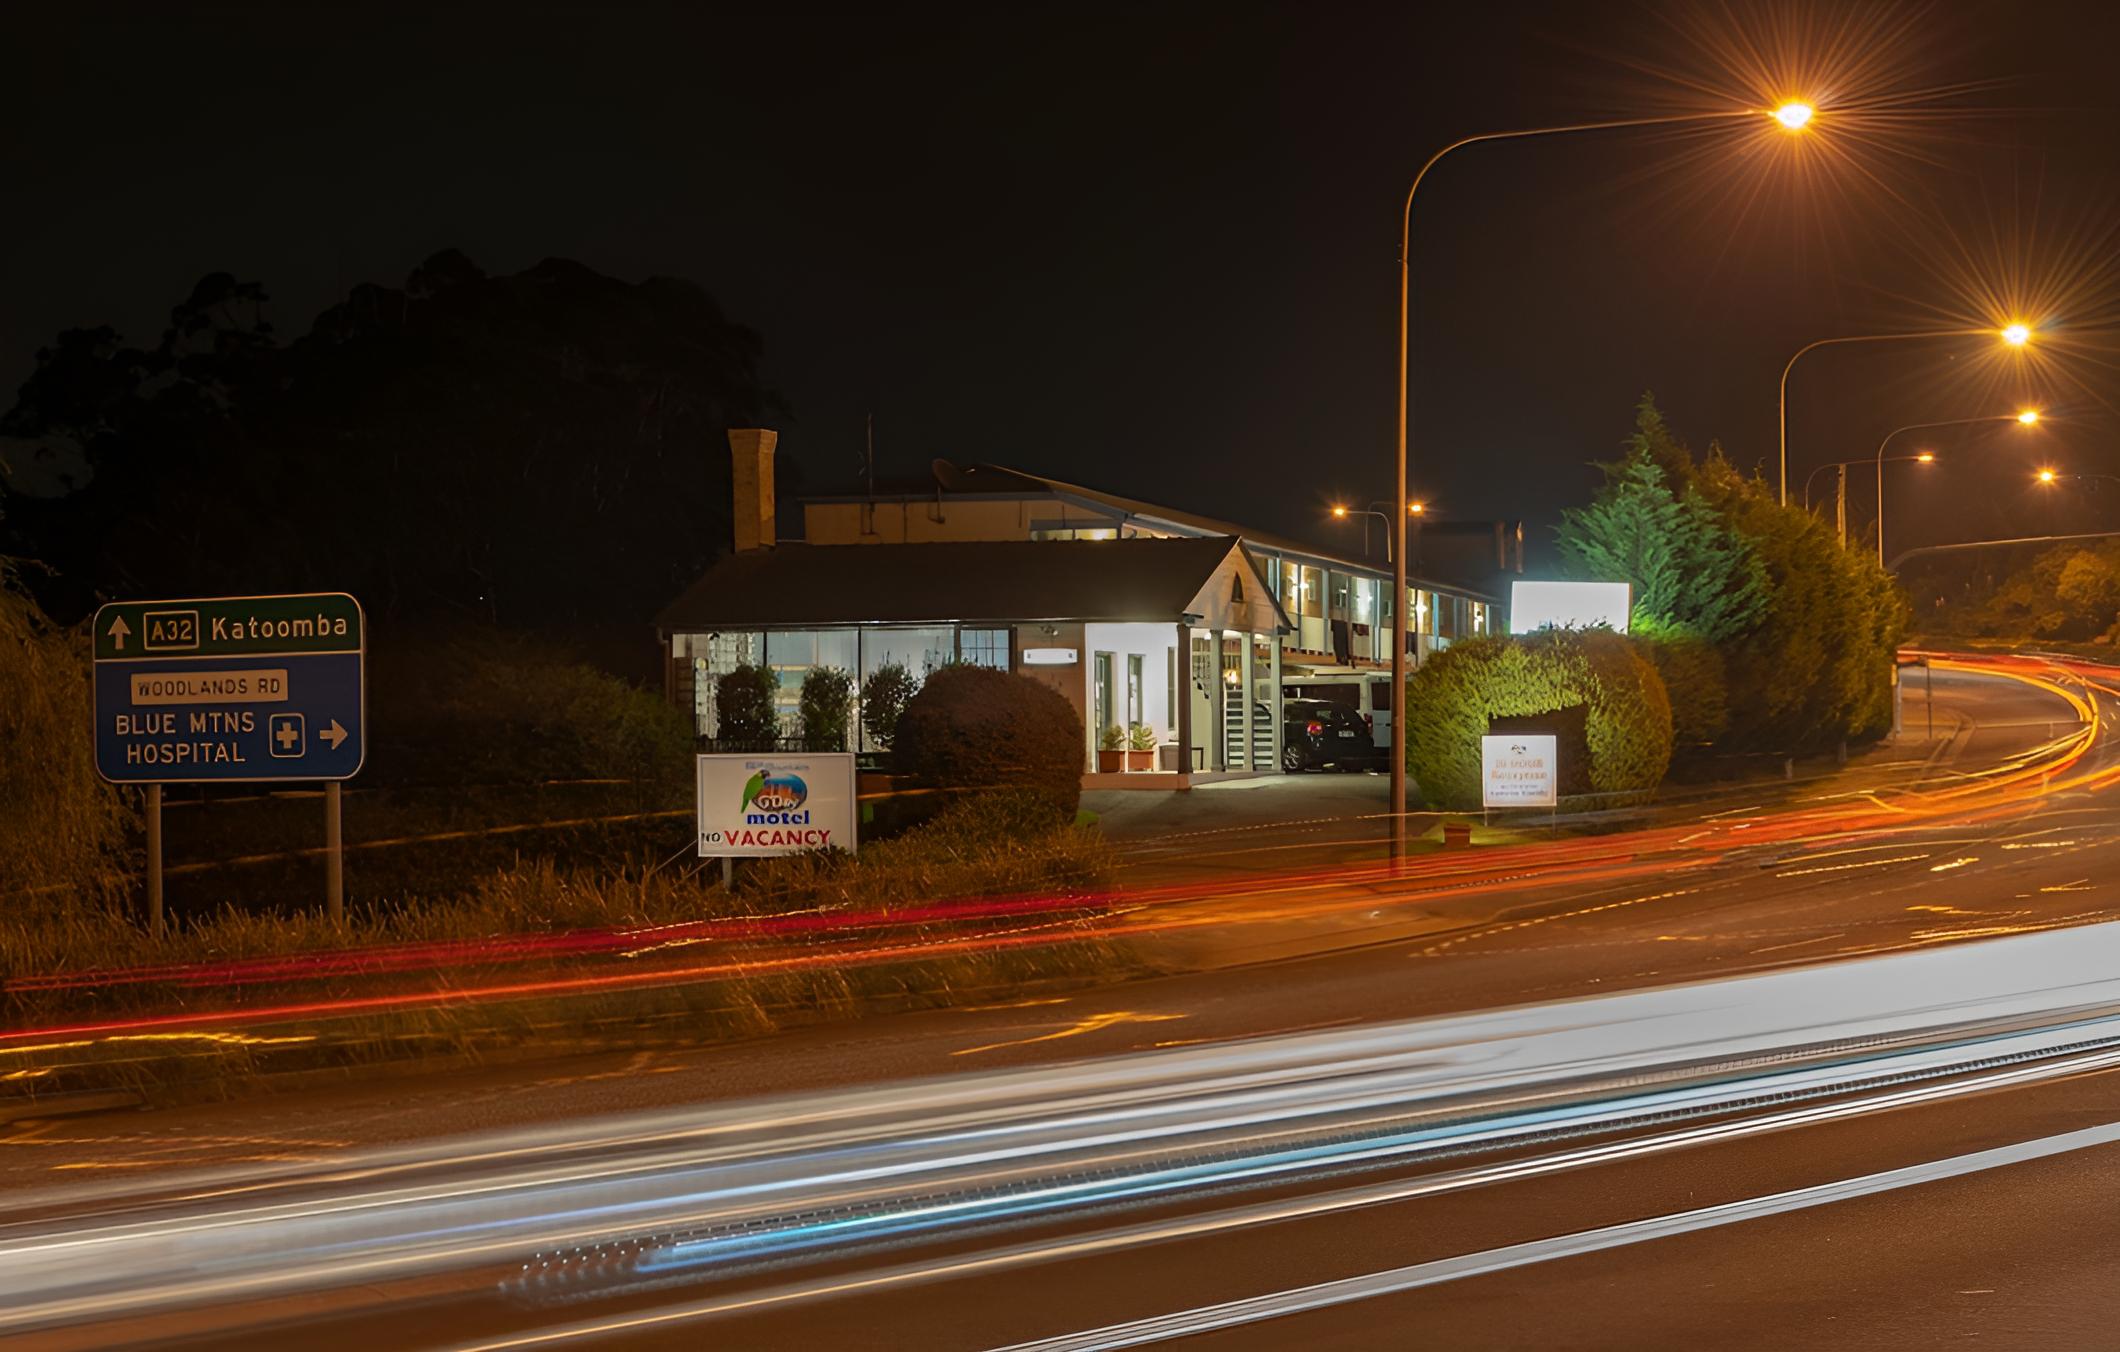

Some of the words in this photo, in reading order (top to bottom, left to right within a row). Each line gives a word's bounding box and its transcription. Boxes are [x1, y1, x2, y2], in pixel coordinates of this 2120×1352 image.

[152, 621, 192, 641] A32
[212, 614, 347, 641] Katoomba
[138, 679, 248, 697] WOODLANDS
[258, 678, 280, 694] RD
[116, 714, 177, 736] BLUE
[190, 711, 255, 734] MTNS
[127, 743, 246, 765] HOSPITAL
[747, 810, 809, 825] motel
[701, 832, 720, 842] NO
[724, 830, 831, 846] VACANCY
